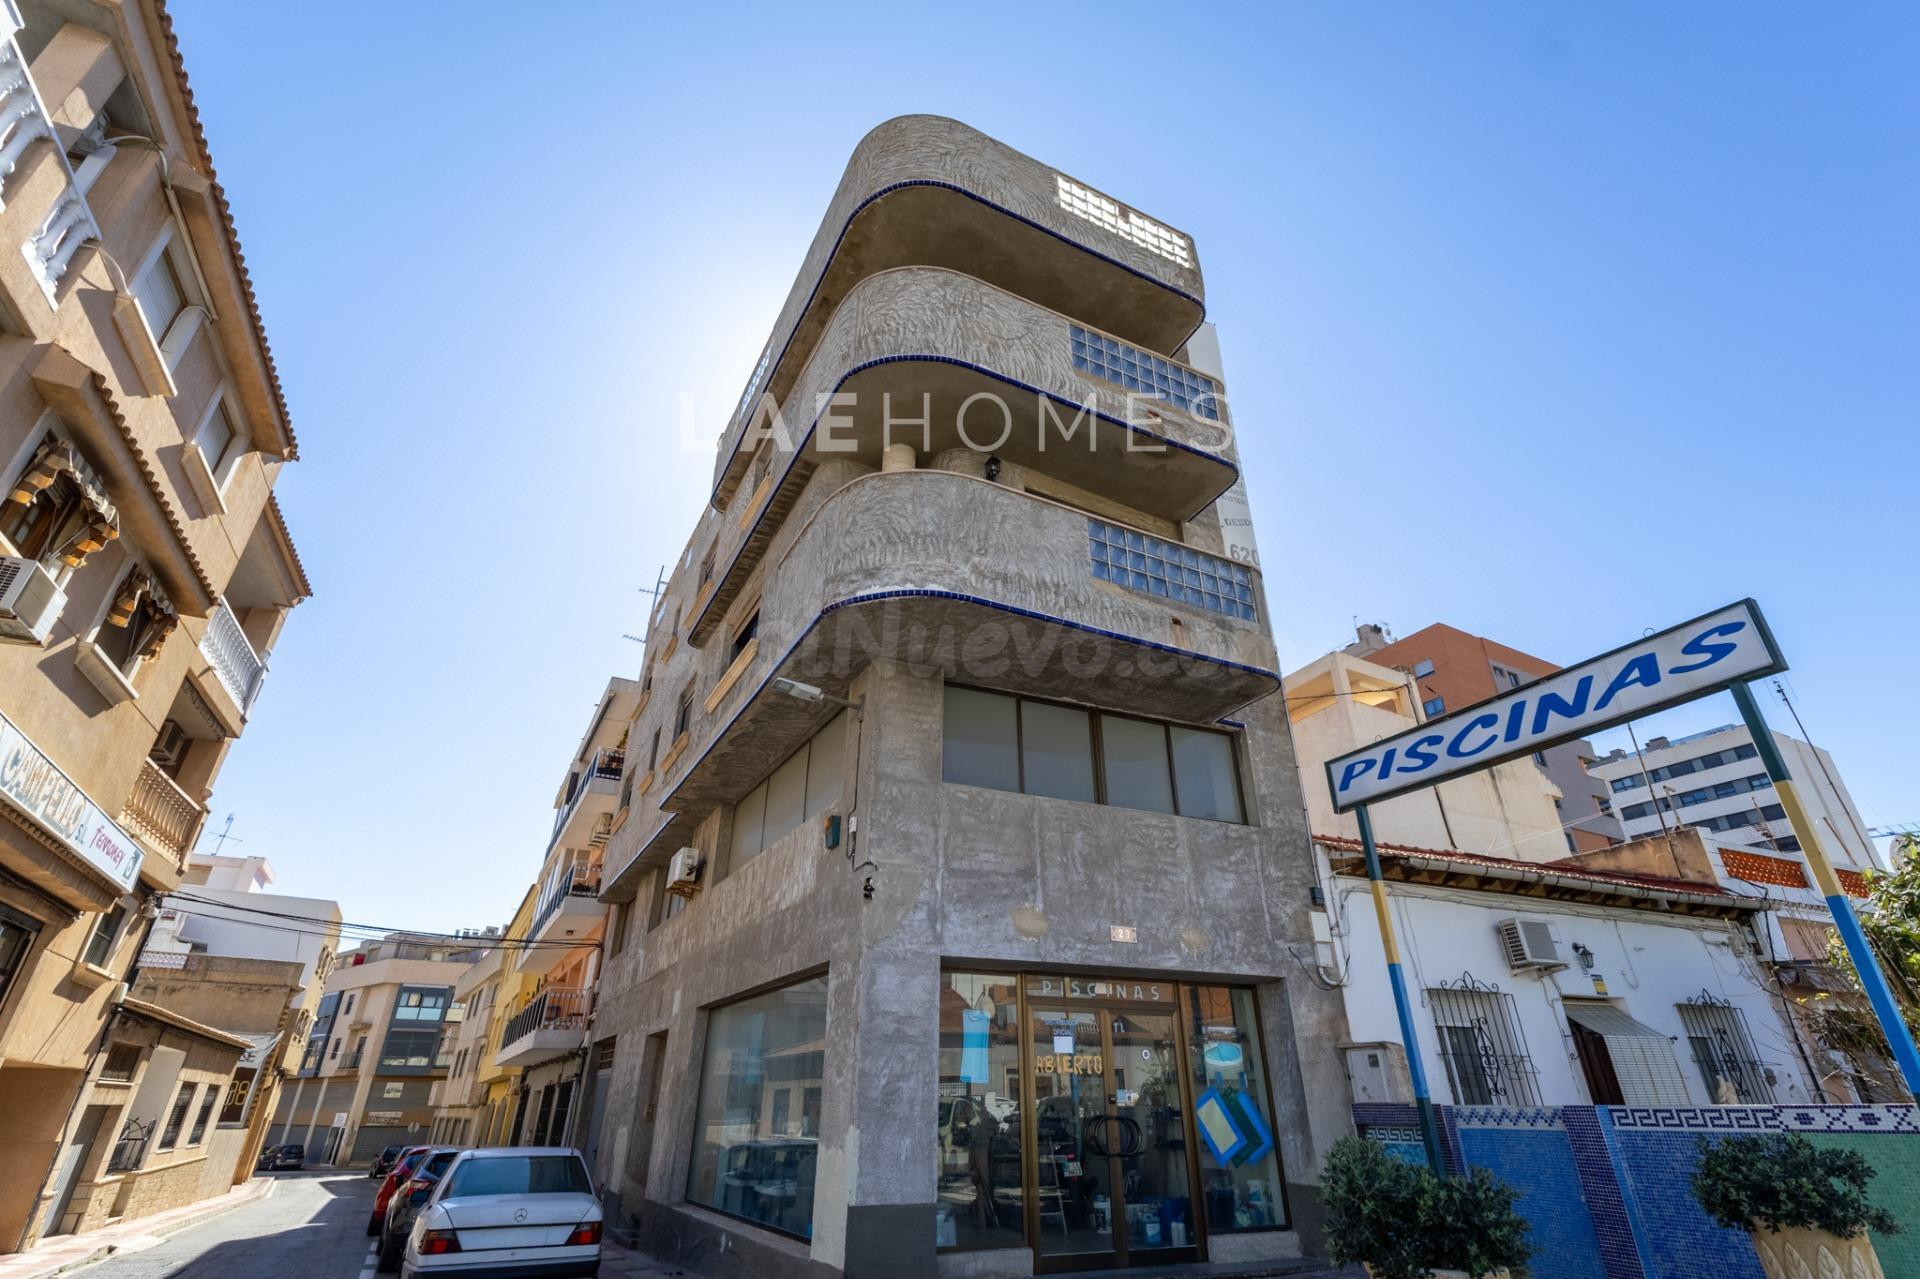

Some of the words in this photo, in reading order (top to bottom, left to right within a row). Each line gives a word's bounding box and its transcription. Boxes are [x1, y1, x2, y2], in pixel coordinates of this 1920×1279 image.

[1339, 621, 1746, 791] PISCINAS
[1042, 980, 1160, 1001] PISCINAS
[1035, 1055, 1103, 1075] ABIERTO
